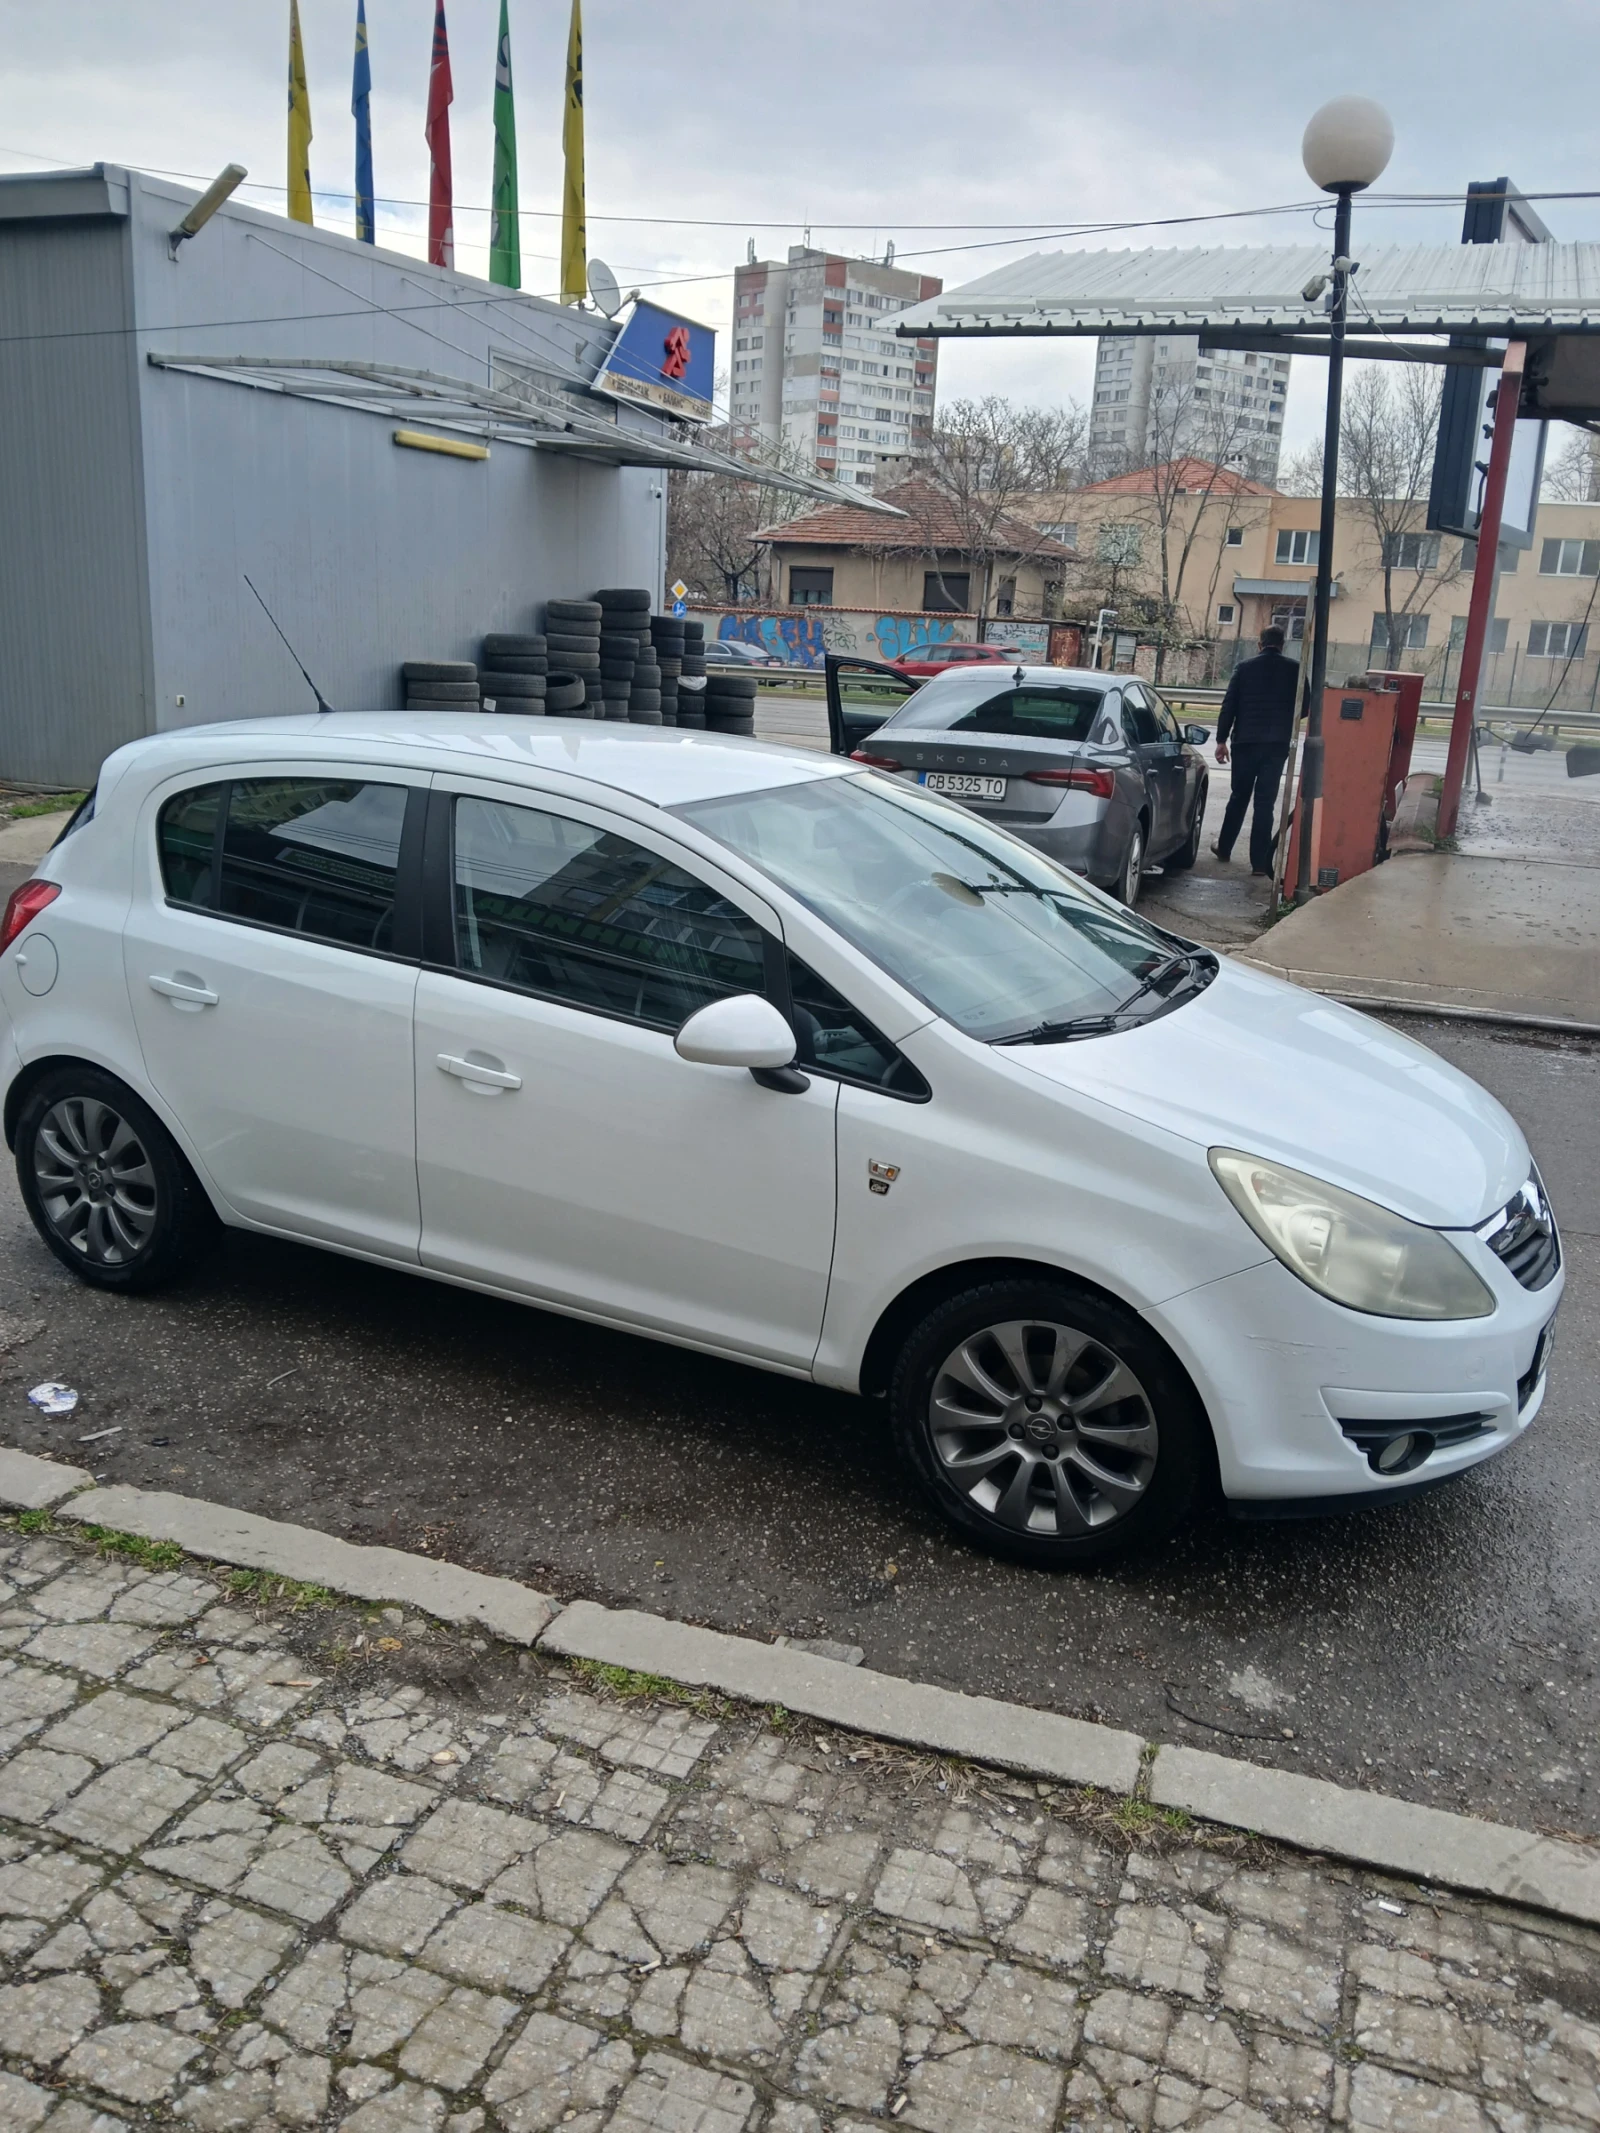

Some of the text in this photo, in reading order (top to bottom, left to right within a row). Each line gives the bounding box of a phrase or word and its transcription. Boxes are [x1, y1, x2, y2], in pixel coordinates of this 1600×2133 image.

[927, 774, 1003, 794] CB 5325 TO
